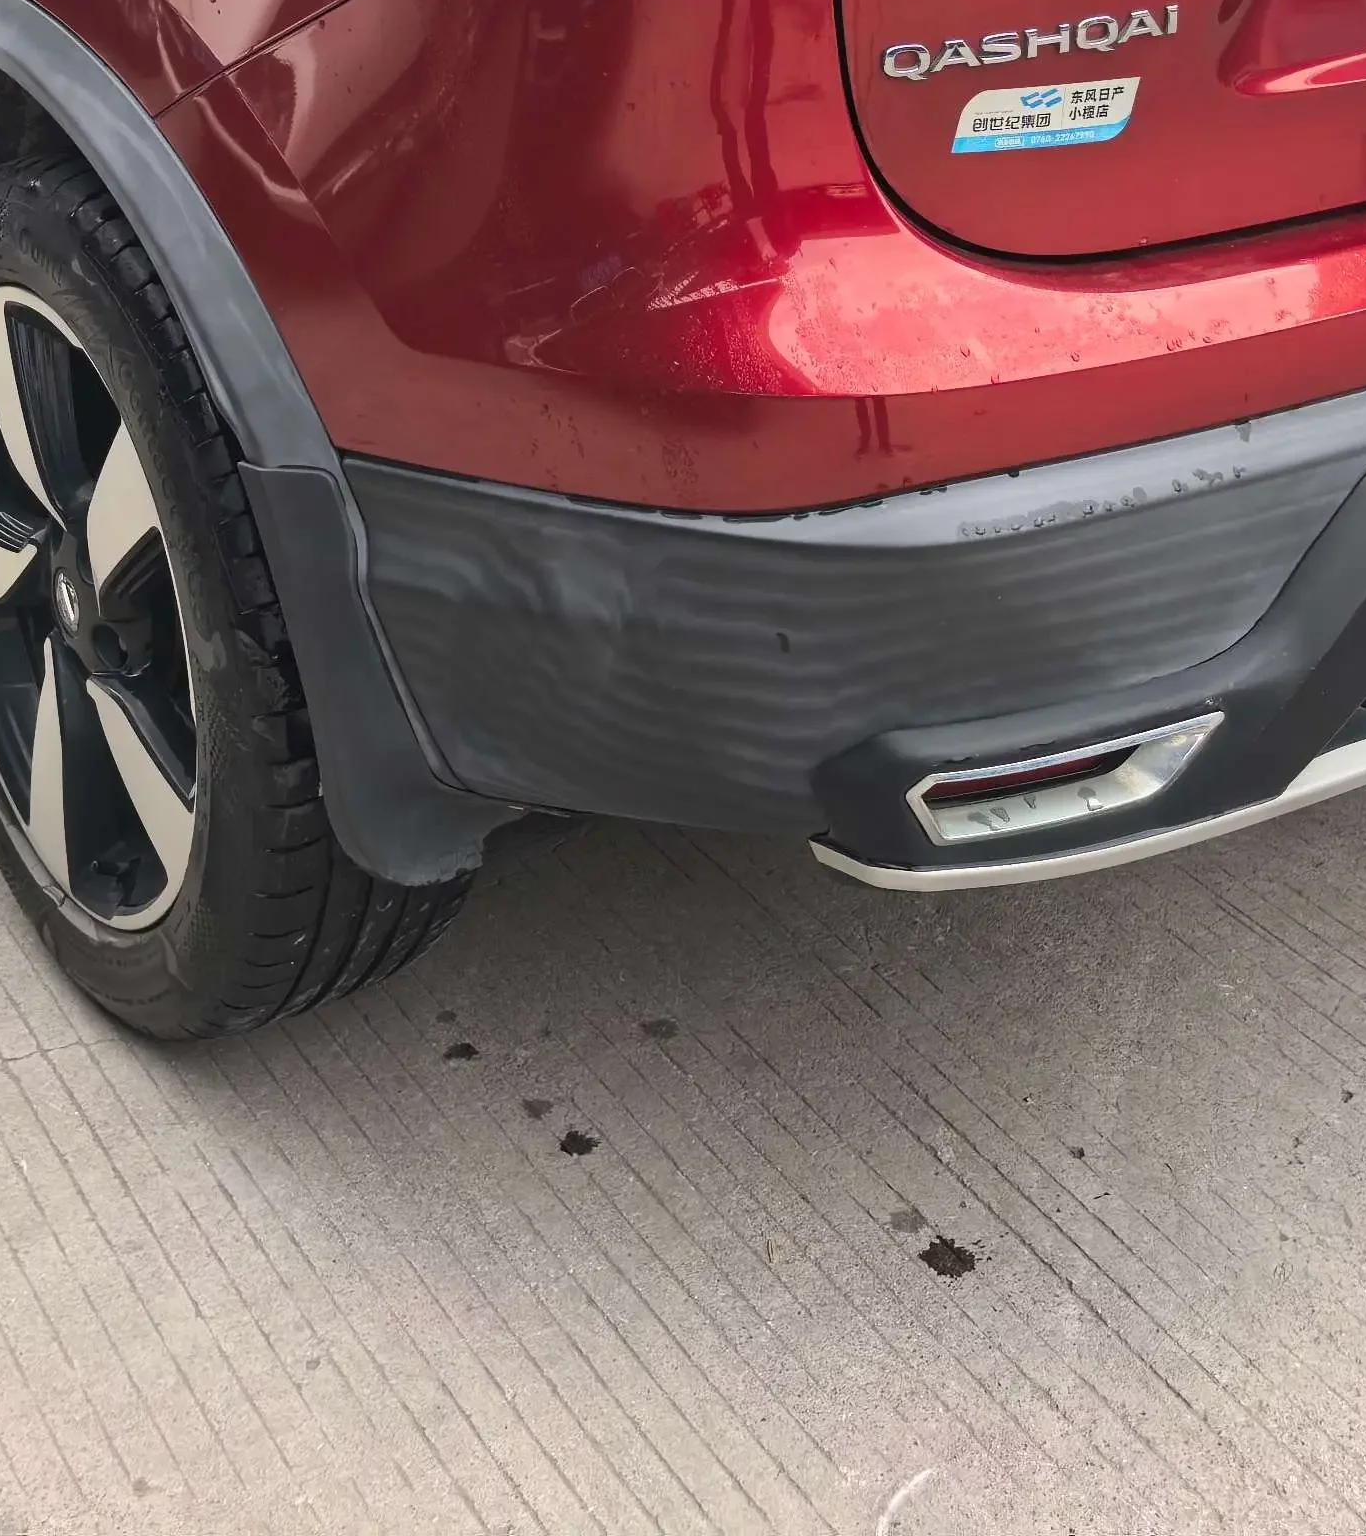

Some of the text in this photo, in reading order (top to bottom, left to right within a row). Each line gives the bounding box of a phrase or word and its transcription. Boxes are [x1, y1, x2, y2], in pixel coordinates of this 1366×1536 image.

[882, 4, 1179, 80] QASHQAI
[1071, 86, 1125, 104] 东风日产
[972, 112, 1052, 132] 创世纪集团
[1069, 104, 1109, 121] 小榄店
